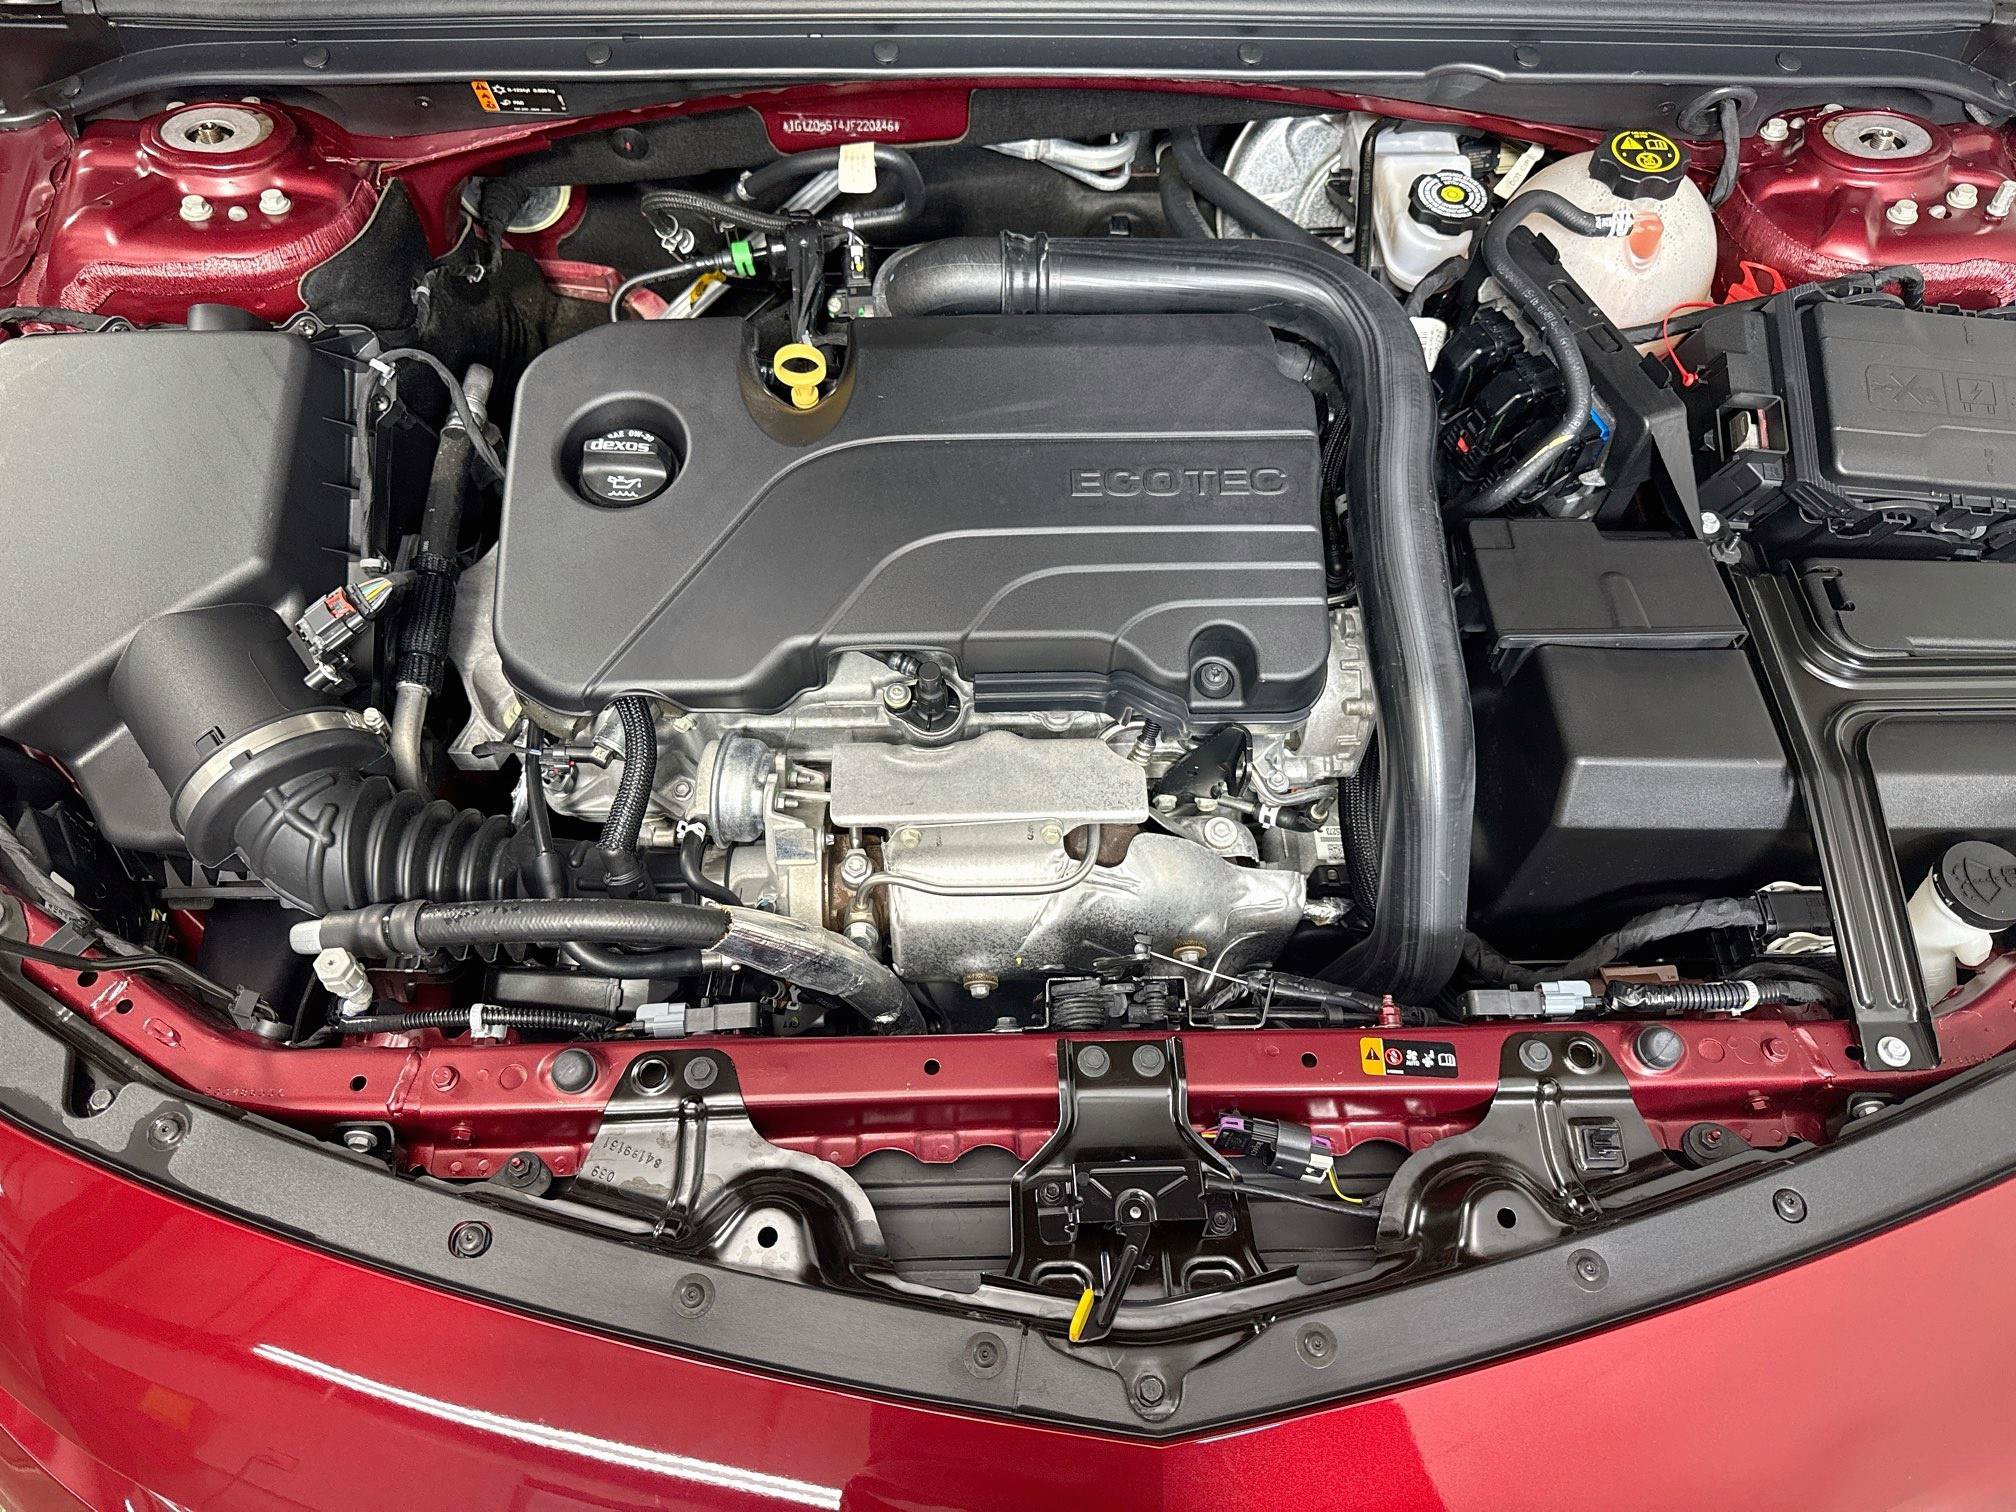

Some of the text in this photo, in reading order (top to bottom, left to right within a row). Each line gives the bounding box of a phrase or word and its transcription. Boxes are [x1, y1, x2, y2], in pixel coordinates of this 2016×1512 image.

[607, 430, 655, 442] SAE 0W-20
[590, 438, 652, 453] dexos
[1070, 468, 1288, 497] ECOTEC
